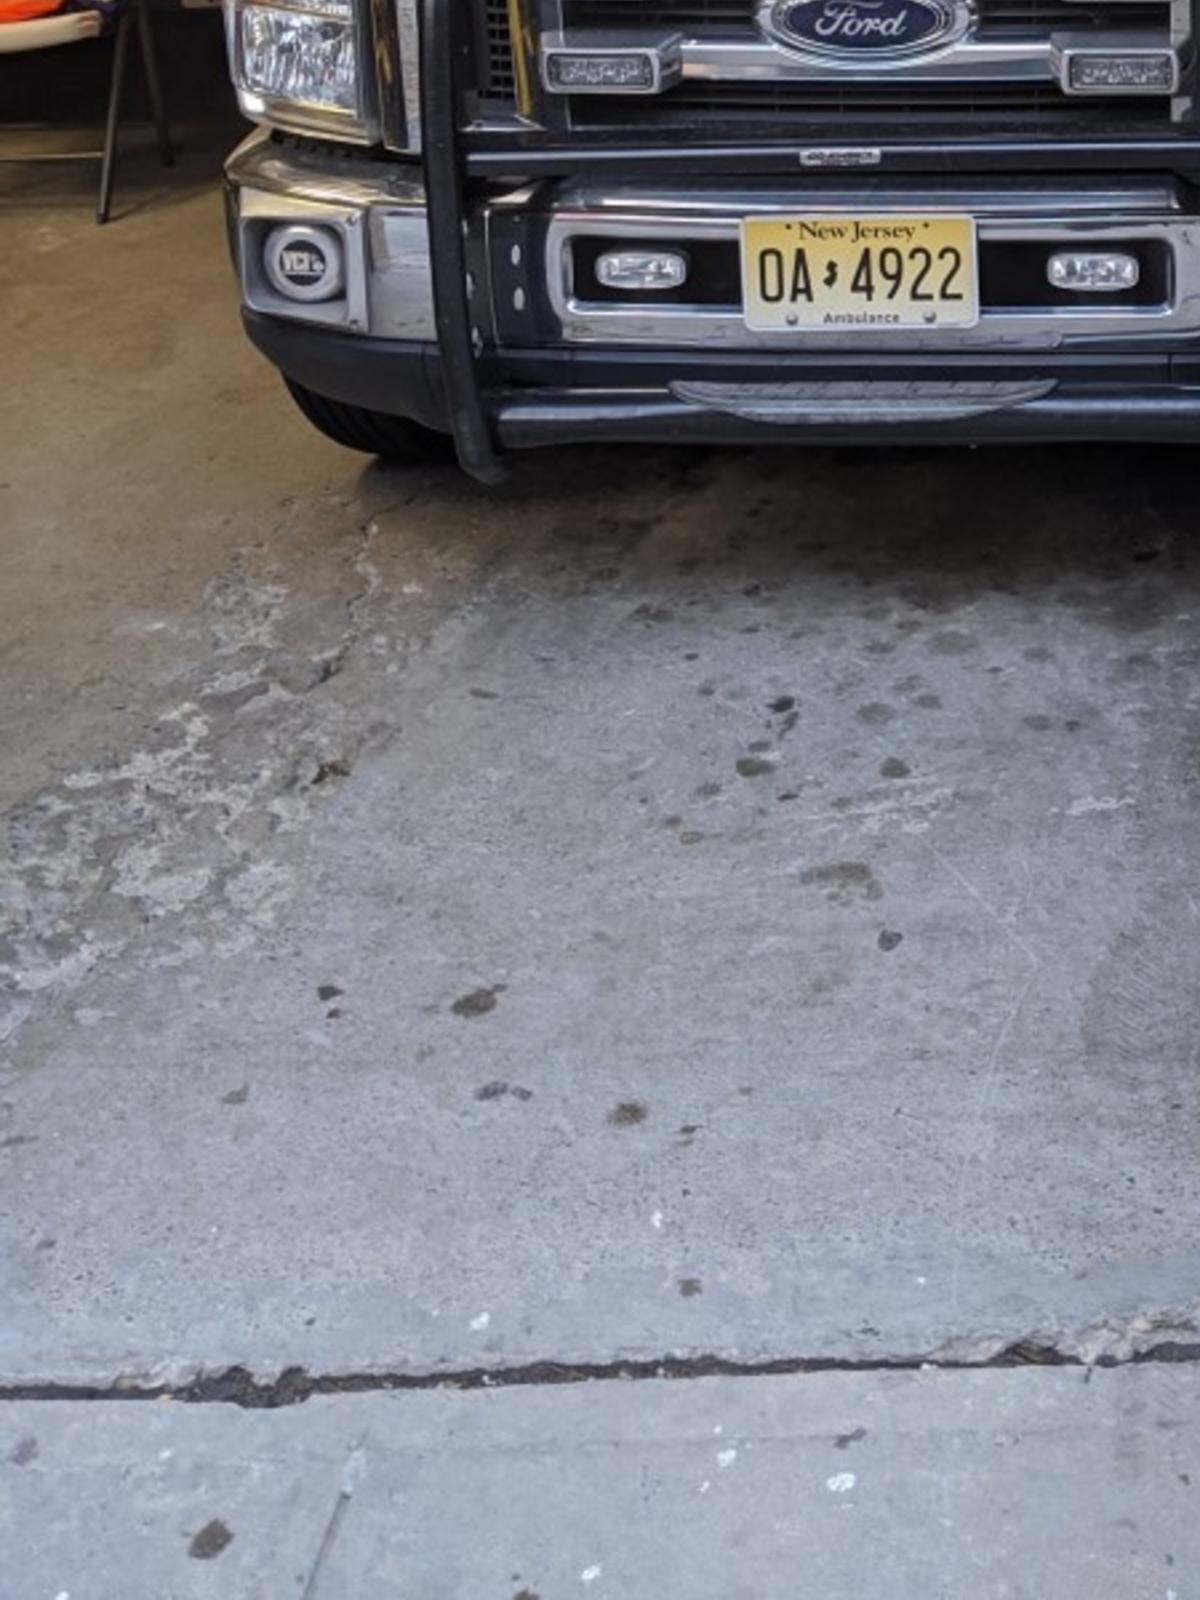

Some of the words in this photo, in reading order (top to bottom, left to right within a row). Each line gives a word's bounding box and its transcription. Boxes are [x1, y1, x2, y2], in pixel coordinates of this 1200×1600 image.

[814, 0, 908, 37] Ford
[798, 221, 849, 240] New
[850, 221, 916, 243] Jersey
[850, 246, 964, 302] 4922
[823, 312, 901, 325] Ambulance
